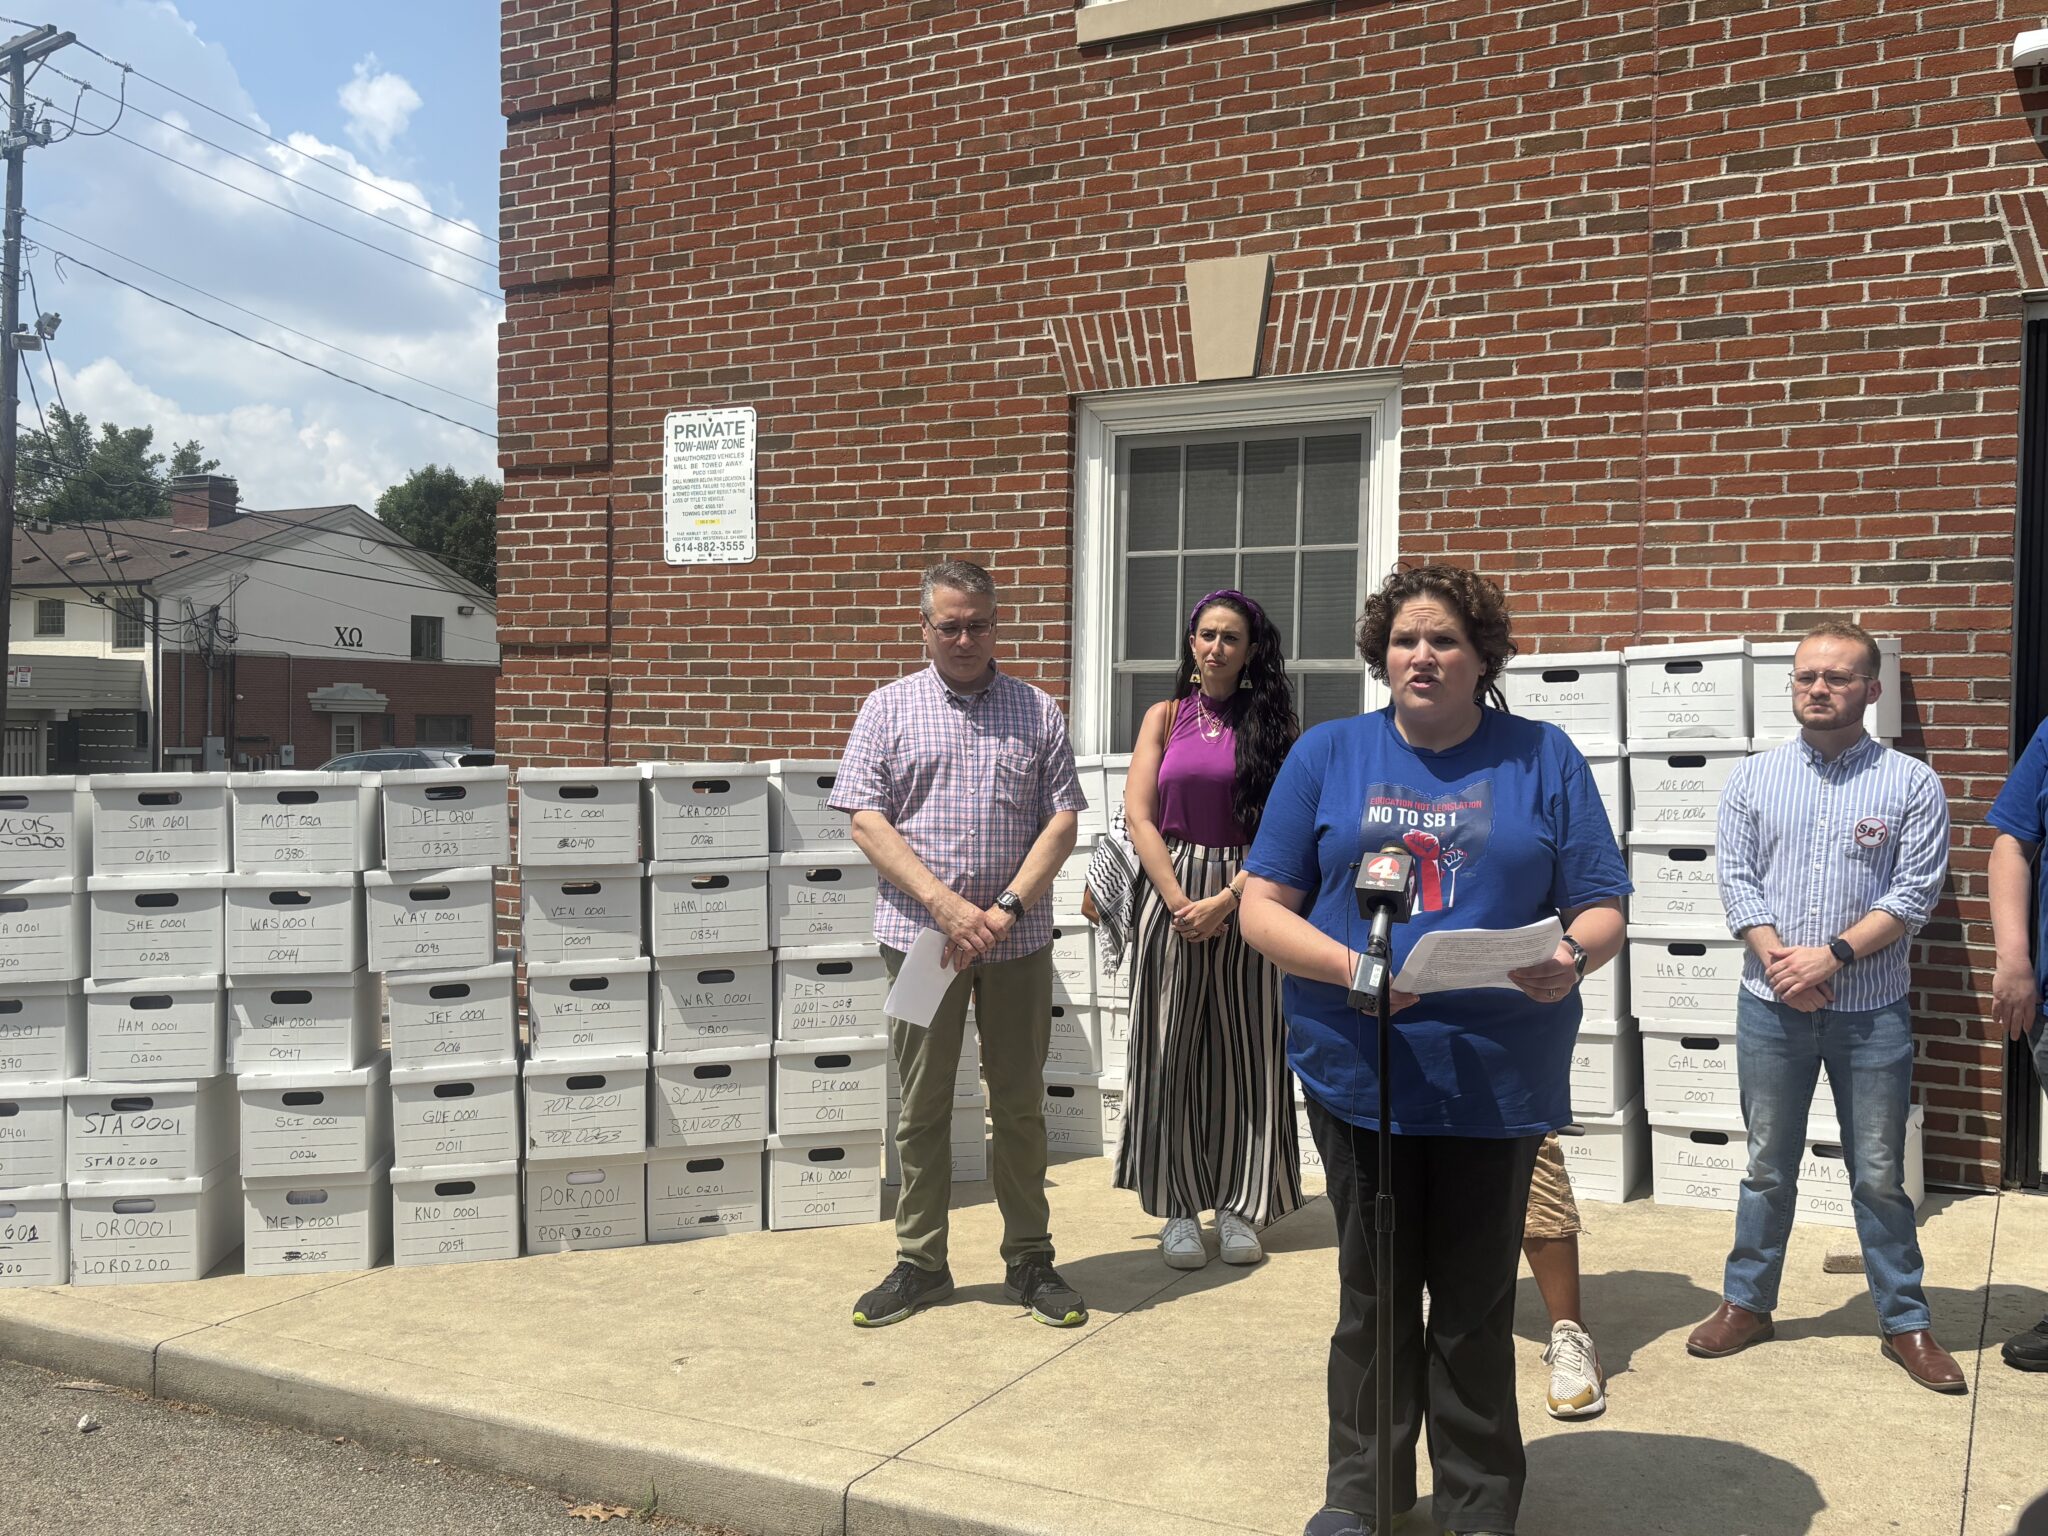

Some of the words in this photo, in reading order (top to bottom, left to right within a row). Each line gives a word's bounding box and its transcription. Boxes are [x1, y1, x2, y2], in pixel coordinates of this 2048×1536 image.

[674, 420, 746, 440] PRIVATE
[674, 440, 719, 453] TOW-AWAY
[721, 438, 745, 450] ZONE
[673, 453, 717, 463] UNAUTHORIZED
[718, 452, 745, 460] VEHICLES
[674, 540, 745, 553] 614-882-3555
[1650, 681, 1681, 695] LAK
[1691, 681, 1716, 694] 0001
[1525, 693, 1549, 703] TRU
[1559, 692, 1585, 702] 0001
[1667, 713, 1700, 724] 0200
[411, 807, 446, 825] DEL
[543, 808, 574, 820] LIC
[580, 809, 605, 819] 0001
[678, 804, 701, 818] CRA
[704, 805, 731, 818] 0001
[1368, 806, 1392, 824] NO
[1397, 808, 1419, 827] TO
[1423, 812, 1446, 828] SB
[1448, 812, 1457, 827] 1
[127, 814, 156, 829] SUM
[162, 815, 190, 829] 0601
[260, 814, 295, 828] MOT
[274, 847, 304, 860] 0380
[421, 842, 459, 855] 0323
[1368, 857, 1393, 879] 4
[1656, 867, 1683, 882] GEA
[1688, 870, 1715, 884] 0201
[796, 891, 817, 904] CLE
[822, 891, 847, 904] 0201
[550, 906, 576, 918] VIN
[584, 906, 607, 916] 0001
[673, 900, 698, 914] HAM
[705, 900, 728, 913] 0001
[1666, 900, 1696, 912] 0215
[126, 919, 155, 931] SHE
[160, 918, 187, 929] 0001
[393, 912, 427, 926] WAY
[434, 912, 461, 923] 0001
[16, 923, 40, 933] 0001
[690, 929, 719, 941] 0834
[139, 951, 170, 962] 0028
[1656, 962, 1687, 978] HAR
[1691, 964, 1718, 978] 0001
[794, 983, 826, 997] PER
[680, 993, 714, 1007] WAR
[723, 993, 752, 1005] 0001
[1668, 995, 1699, 1009] 0006
[553, 1002, 583, 1015] WIL
[289, 1017, 317, 1028] 0001
[424, 1011, 453, 1025] JEF
[459, 1009, 487, 1022] 0001
[117, 1018, 145, 1032] HAM
[151, 1022, 178, 1032] 0001
[572, 1033, 594, 1045] 0011
[130, 1053, 163, 1064] 0200
[269, 1047, 301, 1061] 0047
[1668, 1054, 1699, 1070] GAL
[1702, 1058, 1727, 1071] 0001
[1684, 1091, 1714, 1102] 0007
[422, 1110, 450, 1124] GUE
[453, 1109, 480, 1122] 0001
[815, 1106, 844, 1120] 0011
[82, 1112, 124, 1135] STA
[130, 1115, 181, 1135] 0001
[274, 1116, 304, 1128] SCI
[312, 1117, 338, 1126] 0001
[435, 1140, 463, 1152] 0011
[828, 1169, 852, 1182] 0001
[667, 1185, 691, 1198] LUC
[696, 1185, 724, 1195] 0201
[1685, 1184, 1719, 1198] 0025
[1810, 1198, 1843, 1213] 0400
[414, 1206, 441, 1221] KNO
[452, 1206, 480, 1220] 0001
[677, 1216, 696, 1227] LUC
